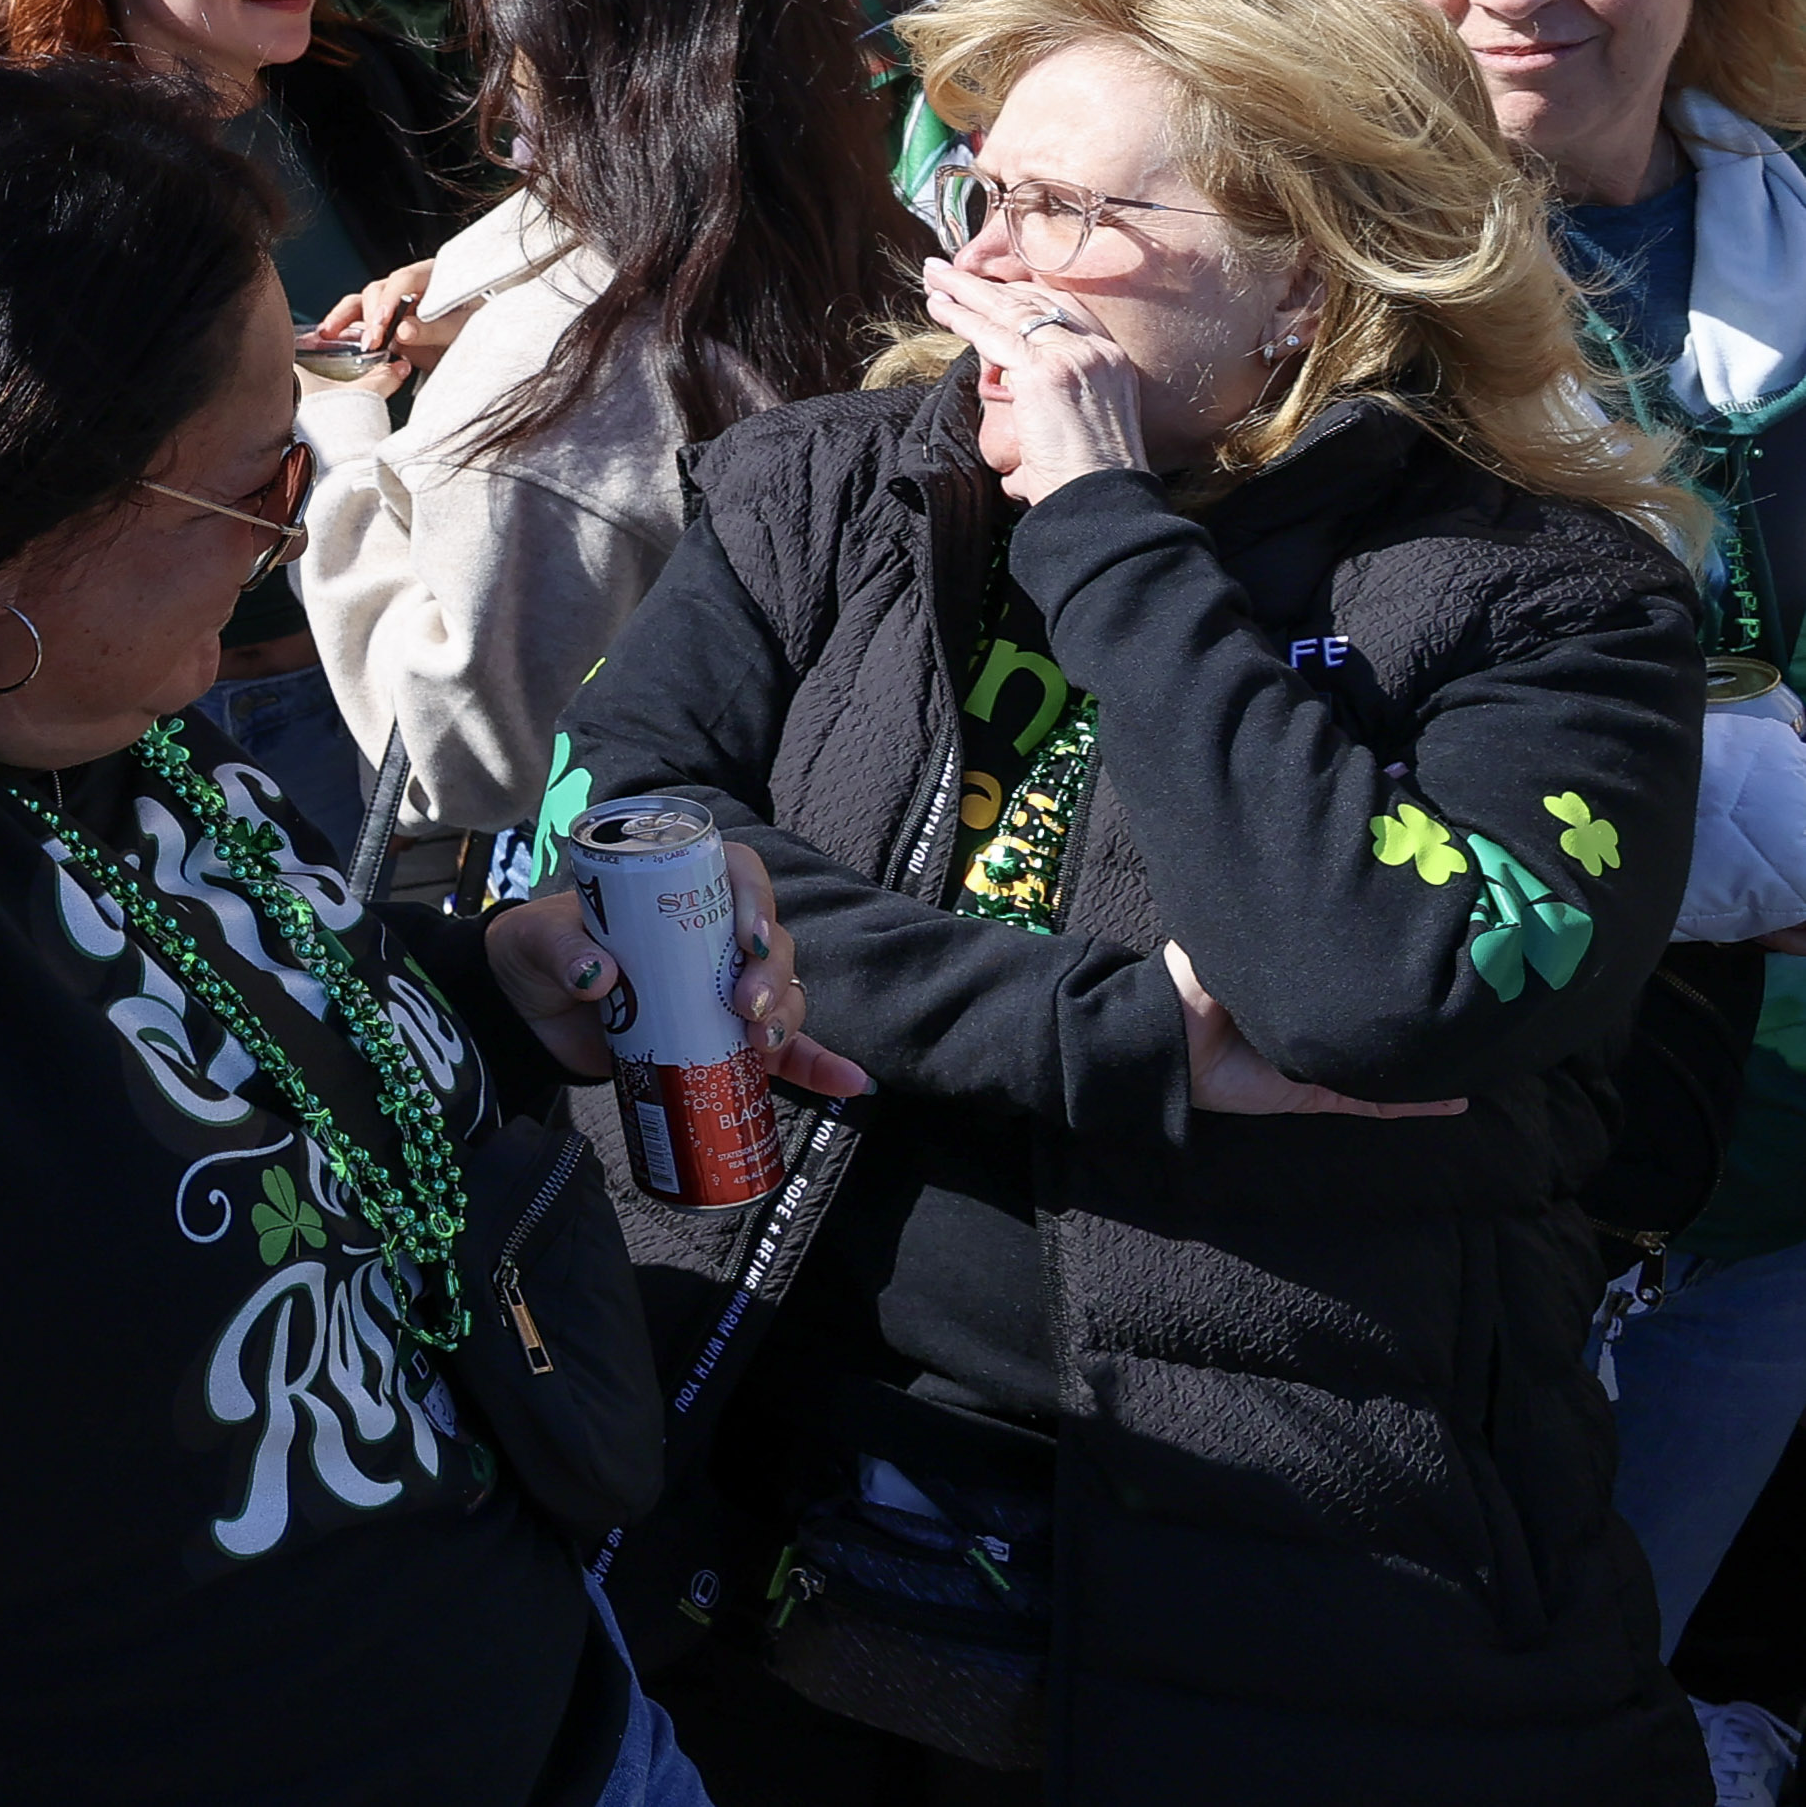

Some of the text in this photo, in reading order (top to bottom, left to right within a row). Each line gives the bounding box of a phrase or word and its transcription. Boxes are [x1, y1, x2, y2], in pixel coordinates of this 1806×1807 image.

[923, 792, 947, 836] WITH
[653, 855, 664, 864] 2g
[908, 840, 931, 875] YOU
[719, 1099, 766, 1130] BLACK
[811, 1119, 836, 1152] YOU
[674, 1238, 777, 1413] BEING WARM WITH YOU
[591, 1548, 614, 1585] WAR
